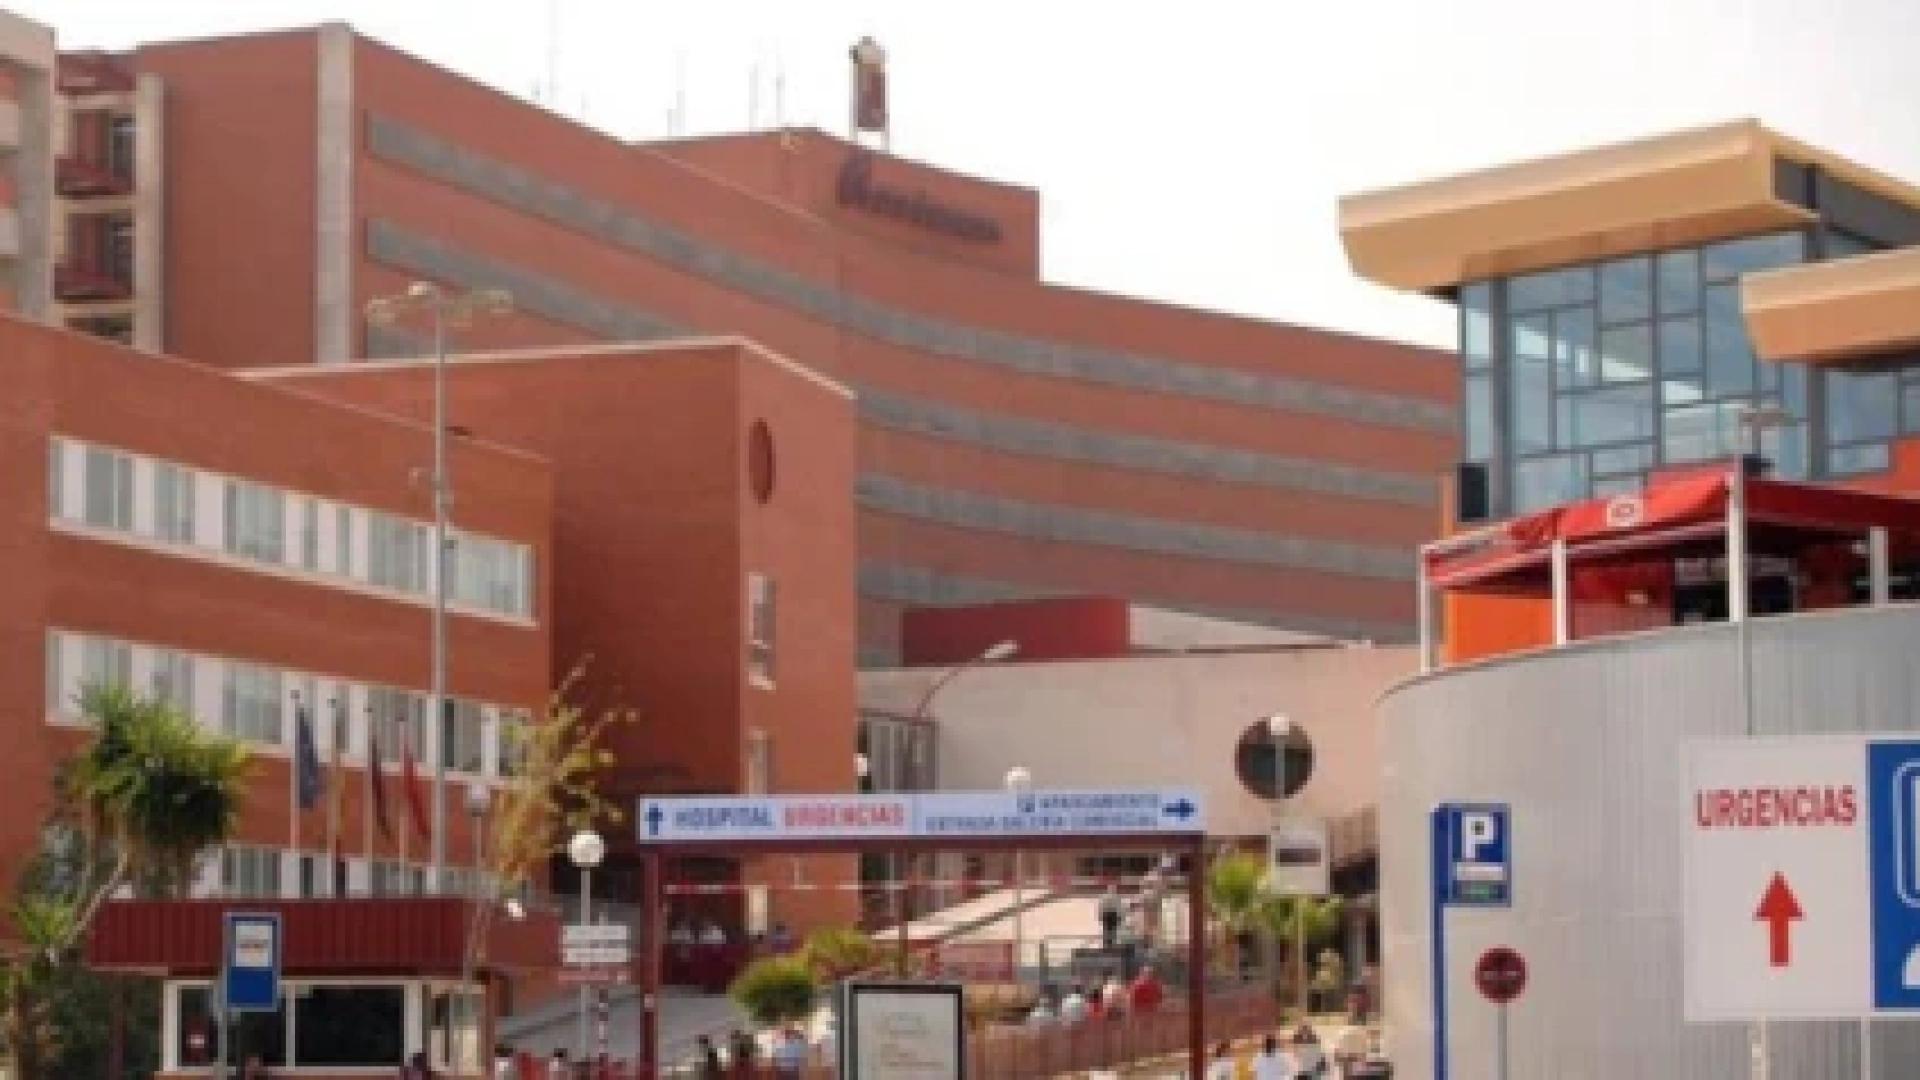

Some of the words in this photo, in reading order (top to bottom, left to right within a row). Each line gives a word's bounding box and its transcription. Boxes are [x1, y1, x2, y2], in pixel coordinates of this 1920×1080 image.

[675, 807, 773, 831] HOSPITAL
[785, 803, 904, 830] URGENCIAS
[1696, 785, 1857, 828] URGENCIAS
